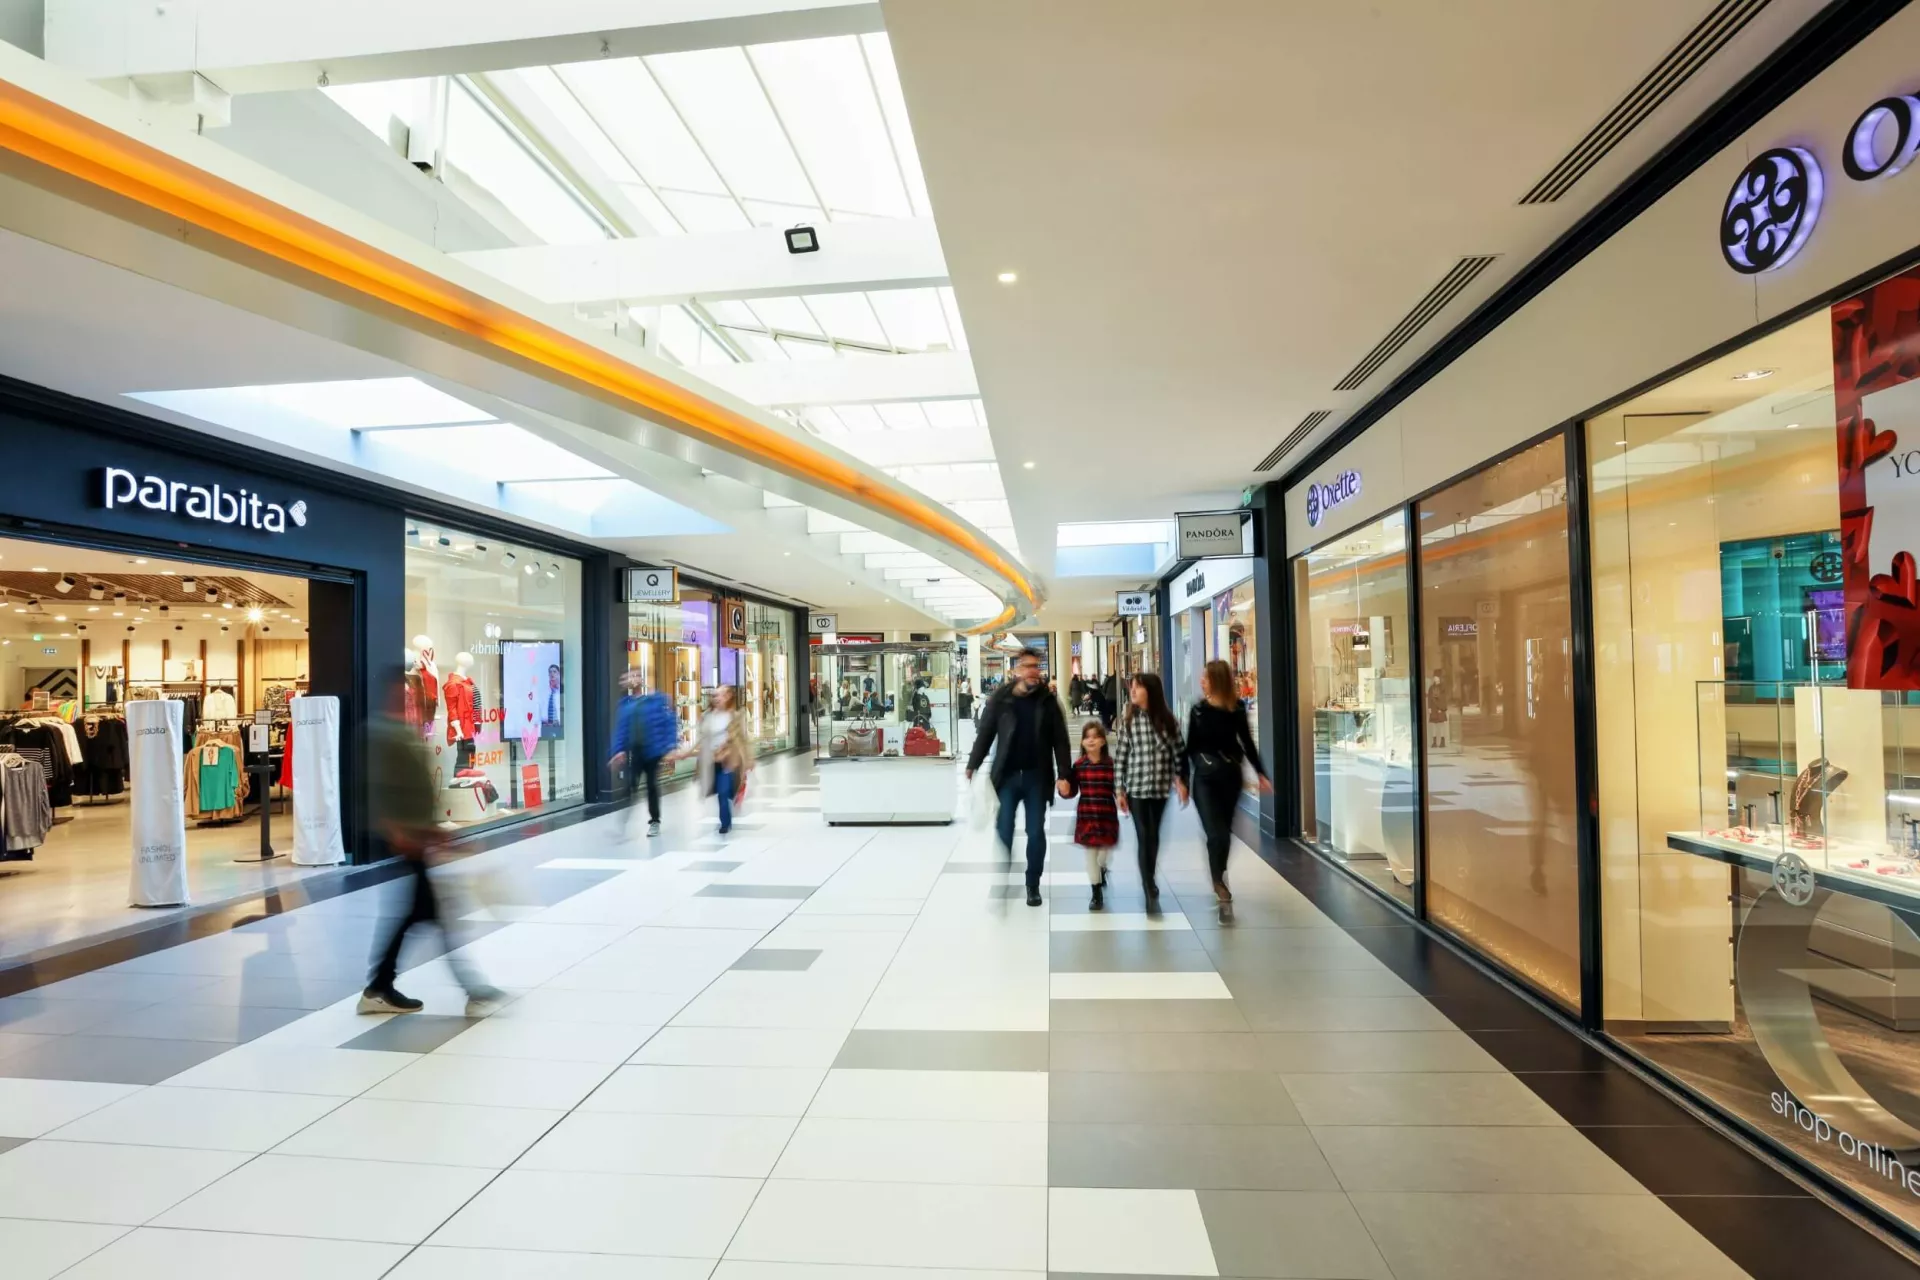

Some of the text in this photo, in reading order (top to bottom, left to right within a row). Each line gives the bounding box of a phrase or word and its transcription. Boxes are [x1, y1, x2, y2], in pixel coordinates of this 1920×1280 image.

[105, 465, 286, 534] parabita
[646, 573, 659, 587] Q
[634, 589, 671, 597] JEWELLERY
[468, 749, 504, 768] HEART
[1770, 1091, 1920, 1198] shop online
